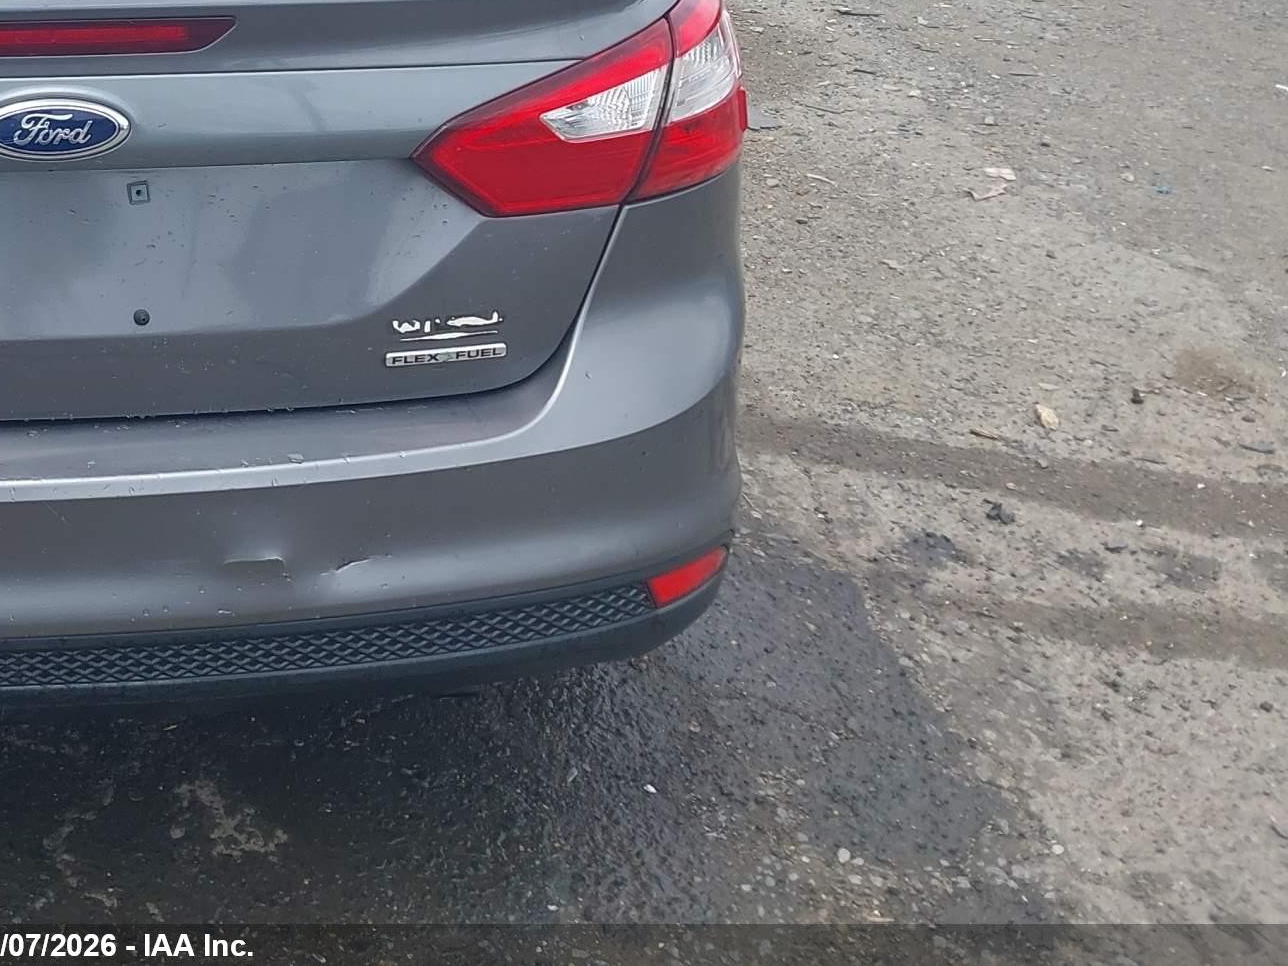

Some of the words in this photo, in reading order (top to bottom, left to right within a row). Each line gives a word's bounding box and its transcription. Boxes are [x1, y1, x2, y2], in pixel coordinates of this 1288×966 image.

[13, 113, 93, 145] Ford
[391, 353, 439, 365] FLEX
[455, 347, 503, 360] FUEL
